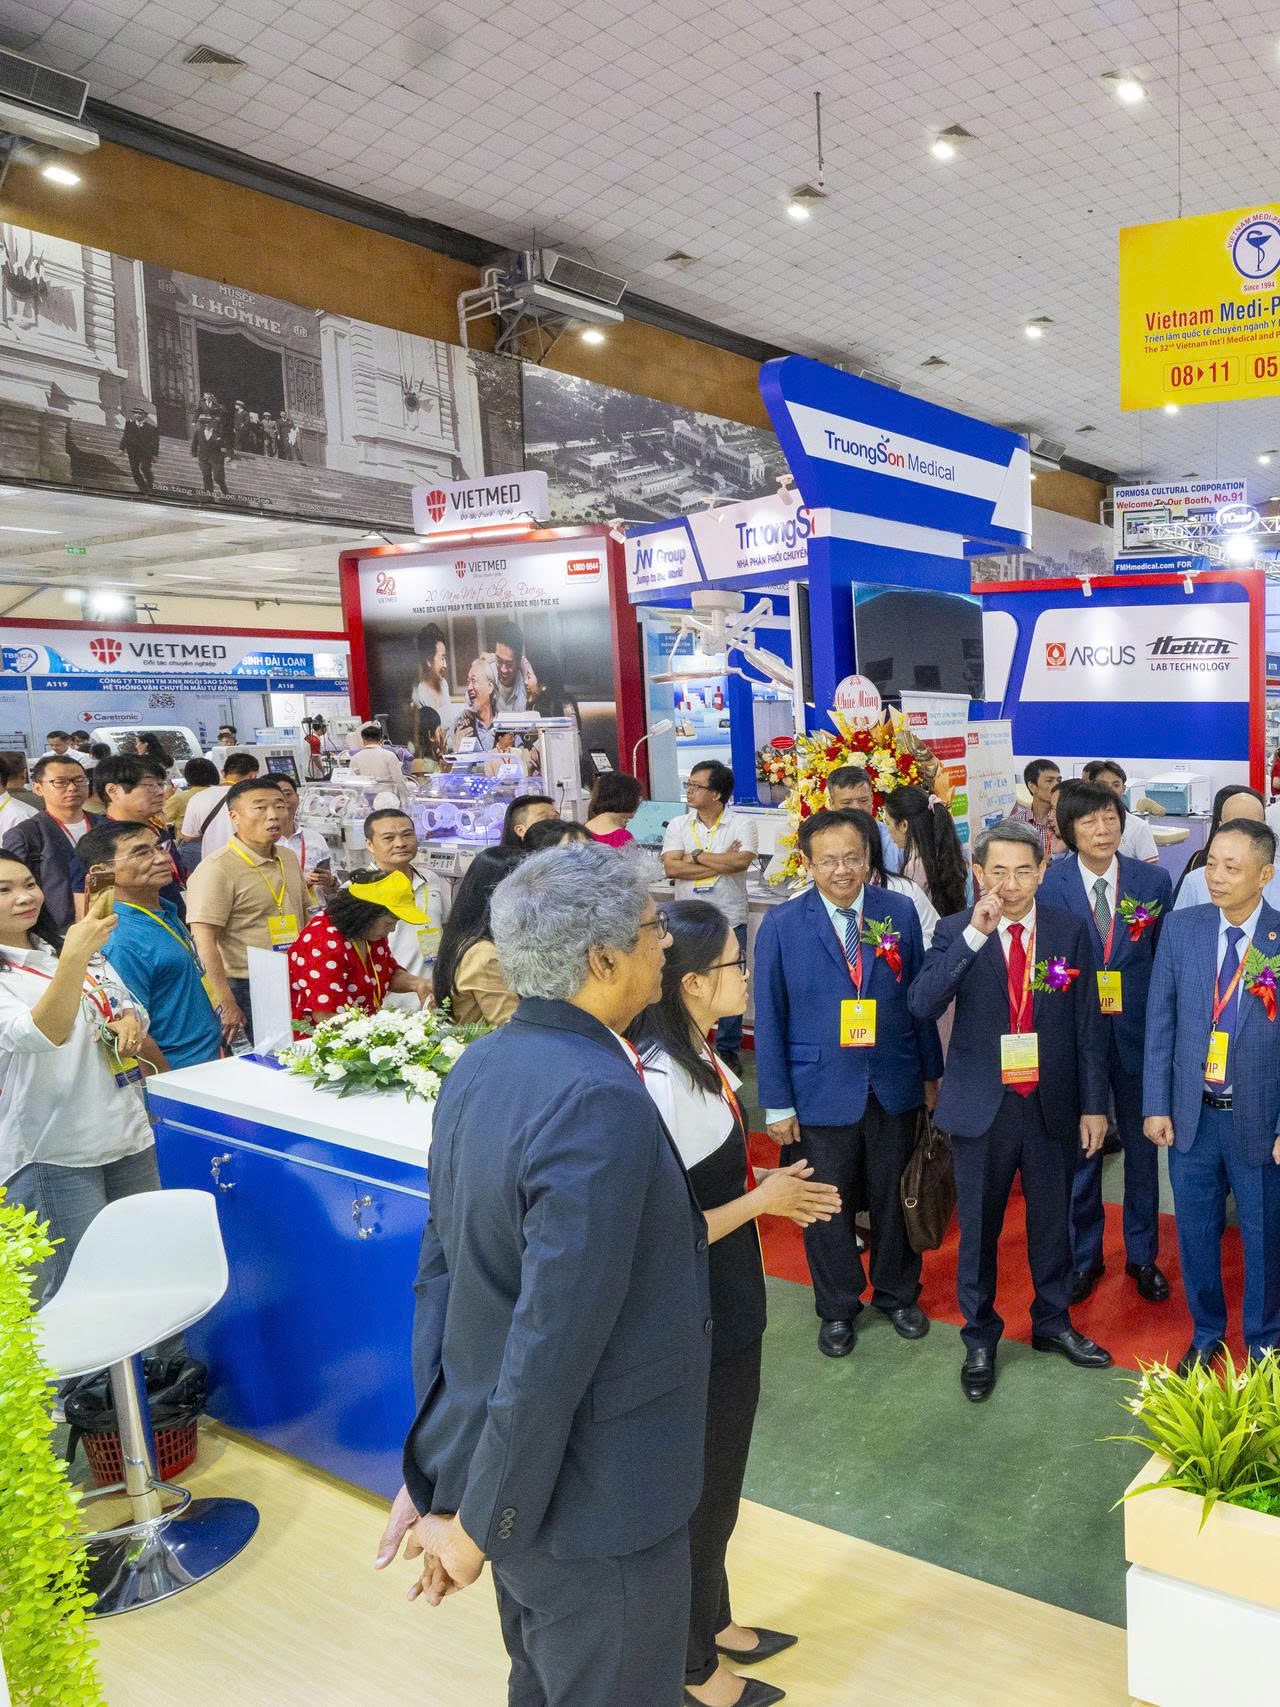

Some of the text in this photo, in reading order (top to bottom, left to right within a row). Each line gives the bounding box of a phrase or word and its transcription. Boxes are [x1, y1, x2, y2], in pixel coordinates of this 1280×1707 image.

[1227, 217, 1251, 248] VIETNAM
[1243, 281, 1275, 292] Since 1994
[192, 293, 282, 334] L'HOMME
[1145, 308, 1213, 331] Vietnam
[1270, 320, 1278, 328] Y
[1144, 345, 1158, 354] The
[1160, 342, 1175, 352] 32nd
[1176, 339, 1208, 350] Vietnam
[1226, 333, 1258, 344] Medical
[1259, 330, 1274, 340] and
[1254, 356, 1278, 378] 05
[824, 430, 955, 482] TruongSon Medical
[450, 484, 520, 510] VIETMED
[1116, 482, 1244, 498] FORMOSA CULTURAL CORPORATION
[1116, 492, 1244, 510] Welcome Our Booth, No.91
[656, 548, 686, 564] Group
[468, 560, 507, 573] VIETMED
[1115, 560, 1192, 572] FMHmedical.com FOR
[128, 642, 227, 660] VIETMED
[1150, 636, 1232, 656] Hettich
[264, 654, 280, 666] ĐÀI
[282, 656, 306, 667] LOAN
[1069, 645, 1136, 666] ARGUS
[1150, 662, 1230, 672] LAB TECHNOLOGY
[102, 684, 114, 692] HỆ
[94, 712, 139, 721] Caretronic
[850, 1028, 867, 1040] VIP
